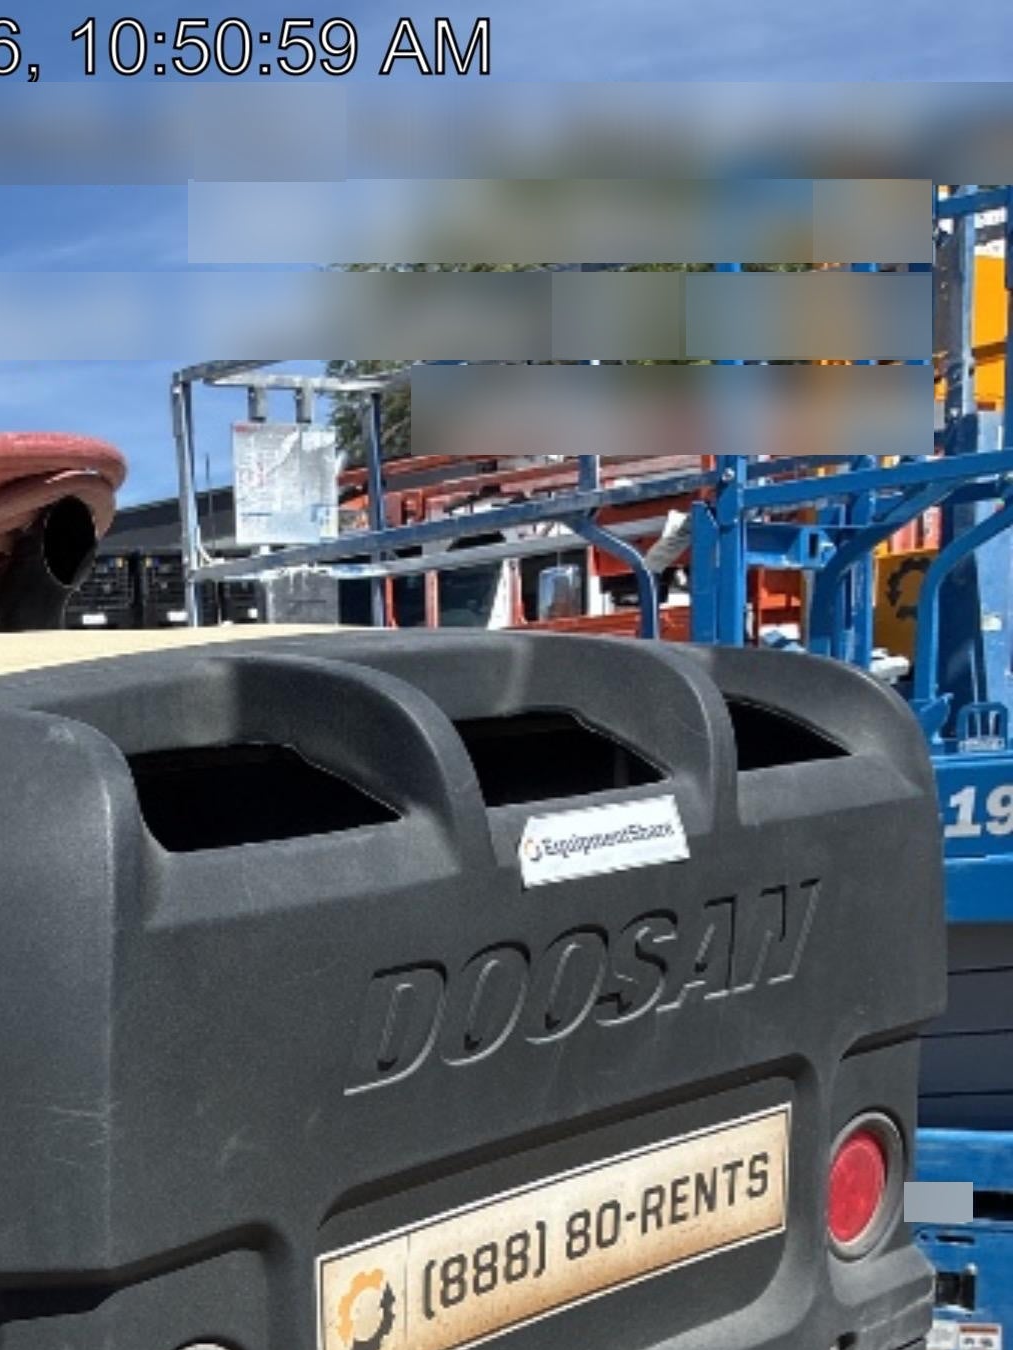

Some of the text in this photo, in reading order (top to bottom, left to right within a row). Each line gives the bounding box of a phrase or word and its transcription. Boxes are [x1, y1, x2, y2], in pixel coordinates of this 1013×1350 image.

[343, 877, 821, 1096] DOOSAN
[423, 1151, 770, 1320] (888) 80-RENTS
